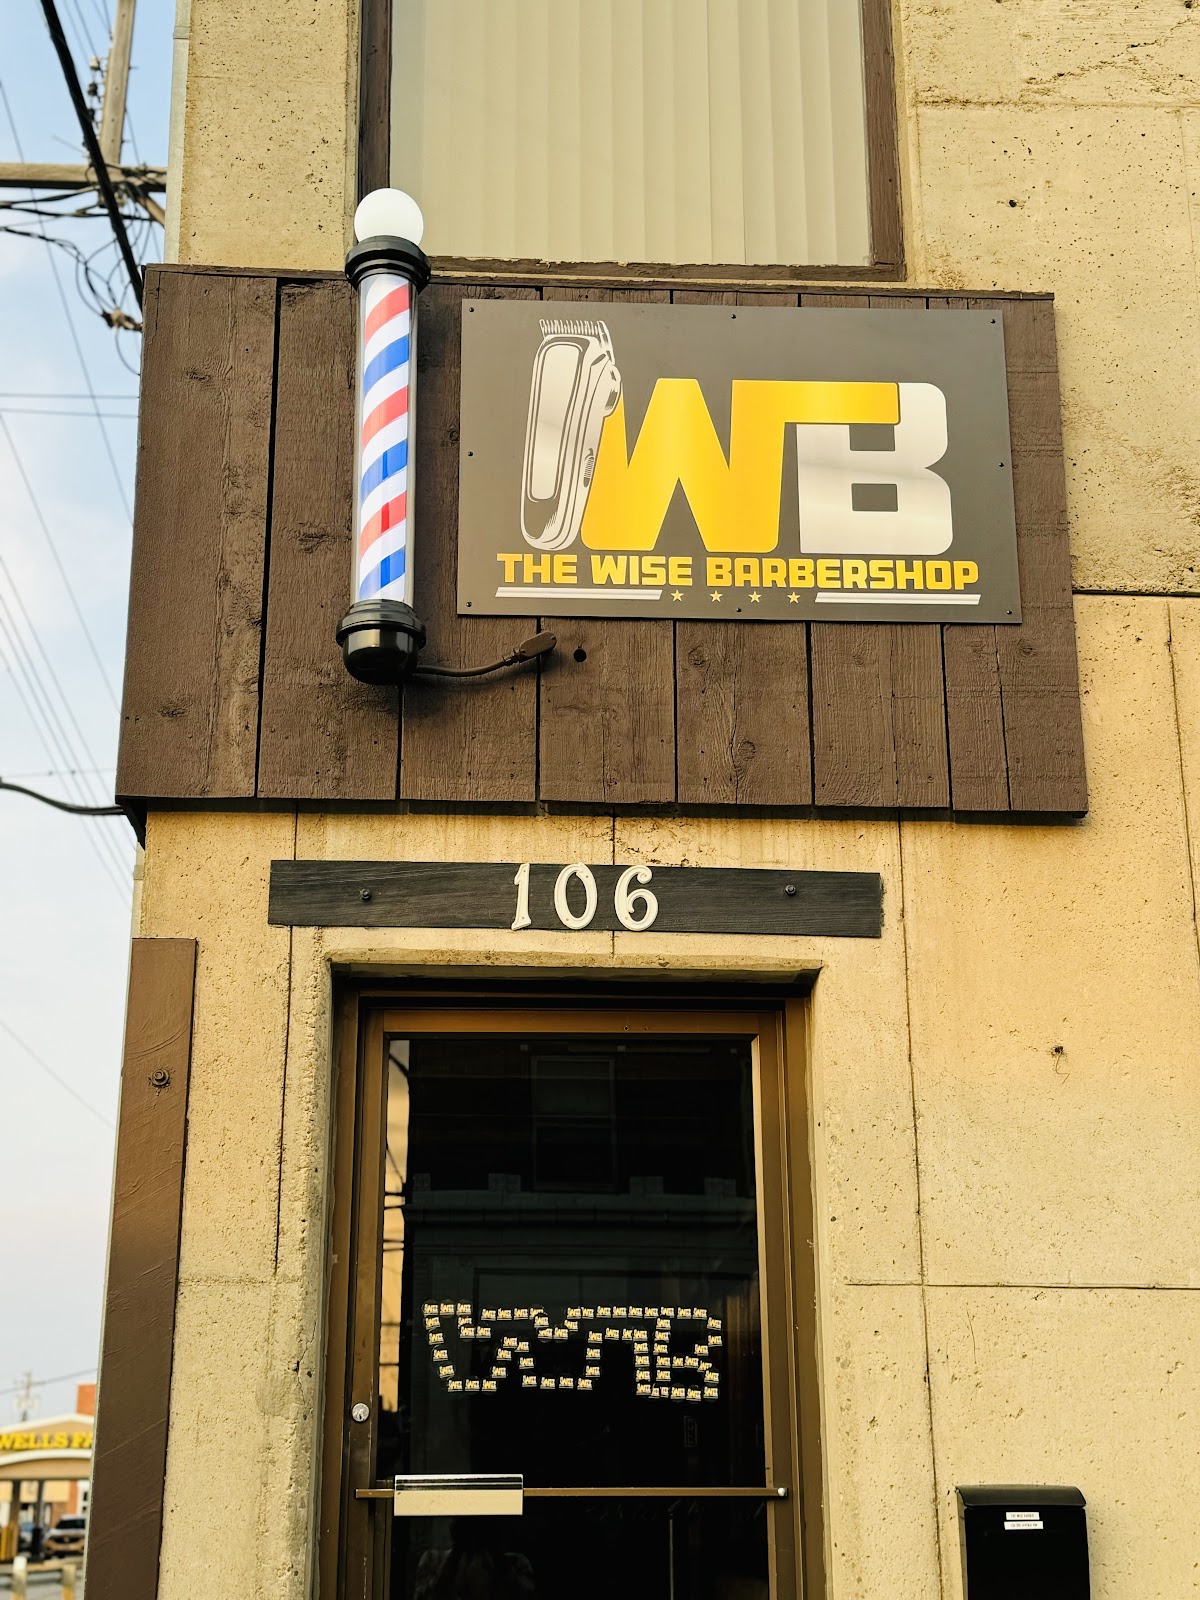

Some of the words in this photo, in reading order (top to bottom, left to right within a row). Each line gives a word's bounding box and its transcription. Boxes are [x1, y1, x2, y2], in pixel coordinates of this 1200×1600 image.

[580, 377, 953, 555] WB
[496, 553, 578, 585] THE
[591, 555, 692, 587] WISE
[706, 557, 979, 591] BARBERSHOP
[510, 862, 659, 932] 106
[0, 1431, 69, 1450] WELLS
